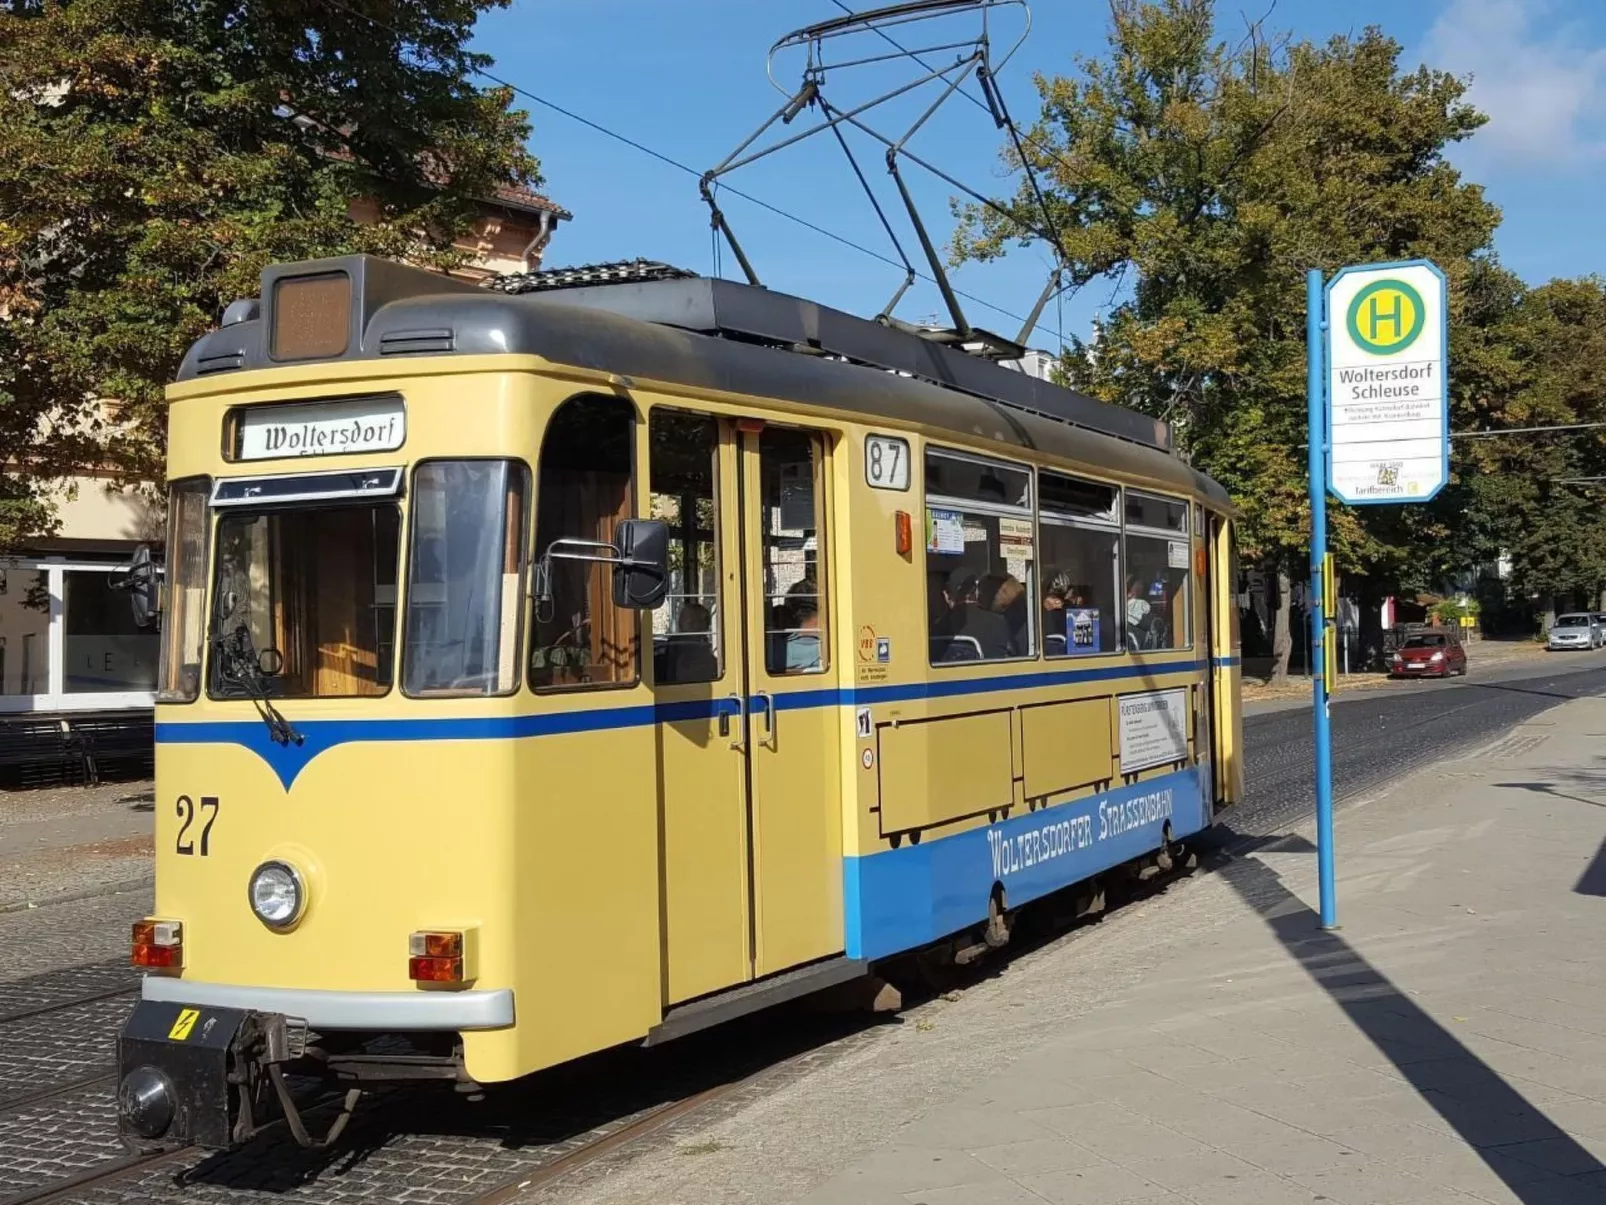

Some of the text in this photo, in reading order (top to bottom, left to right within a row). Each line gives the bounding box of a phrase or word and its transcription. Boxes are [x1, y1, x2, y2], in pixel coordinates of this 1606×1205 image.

[1370, 295, 1401, 339] H
[1339, 363, 1432, 385] Woltersdorf
[1352, 383, 1420, 400] Schleuse
[265, 417, 396, 451] Woltersdorf
[870, 441, 901, 484] 87
[175, 794, 219, 857] 27
[987, 788, 1173, 878] WOLTERSDORFER STRASSENBAHN
